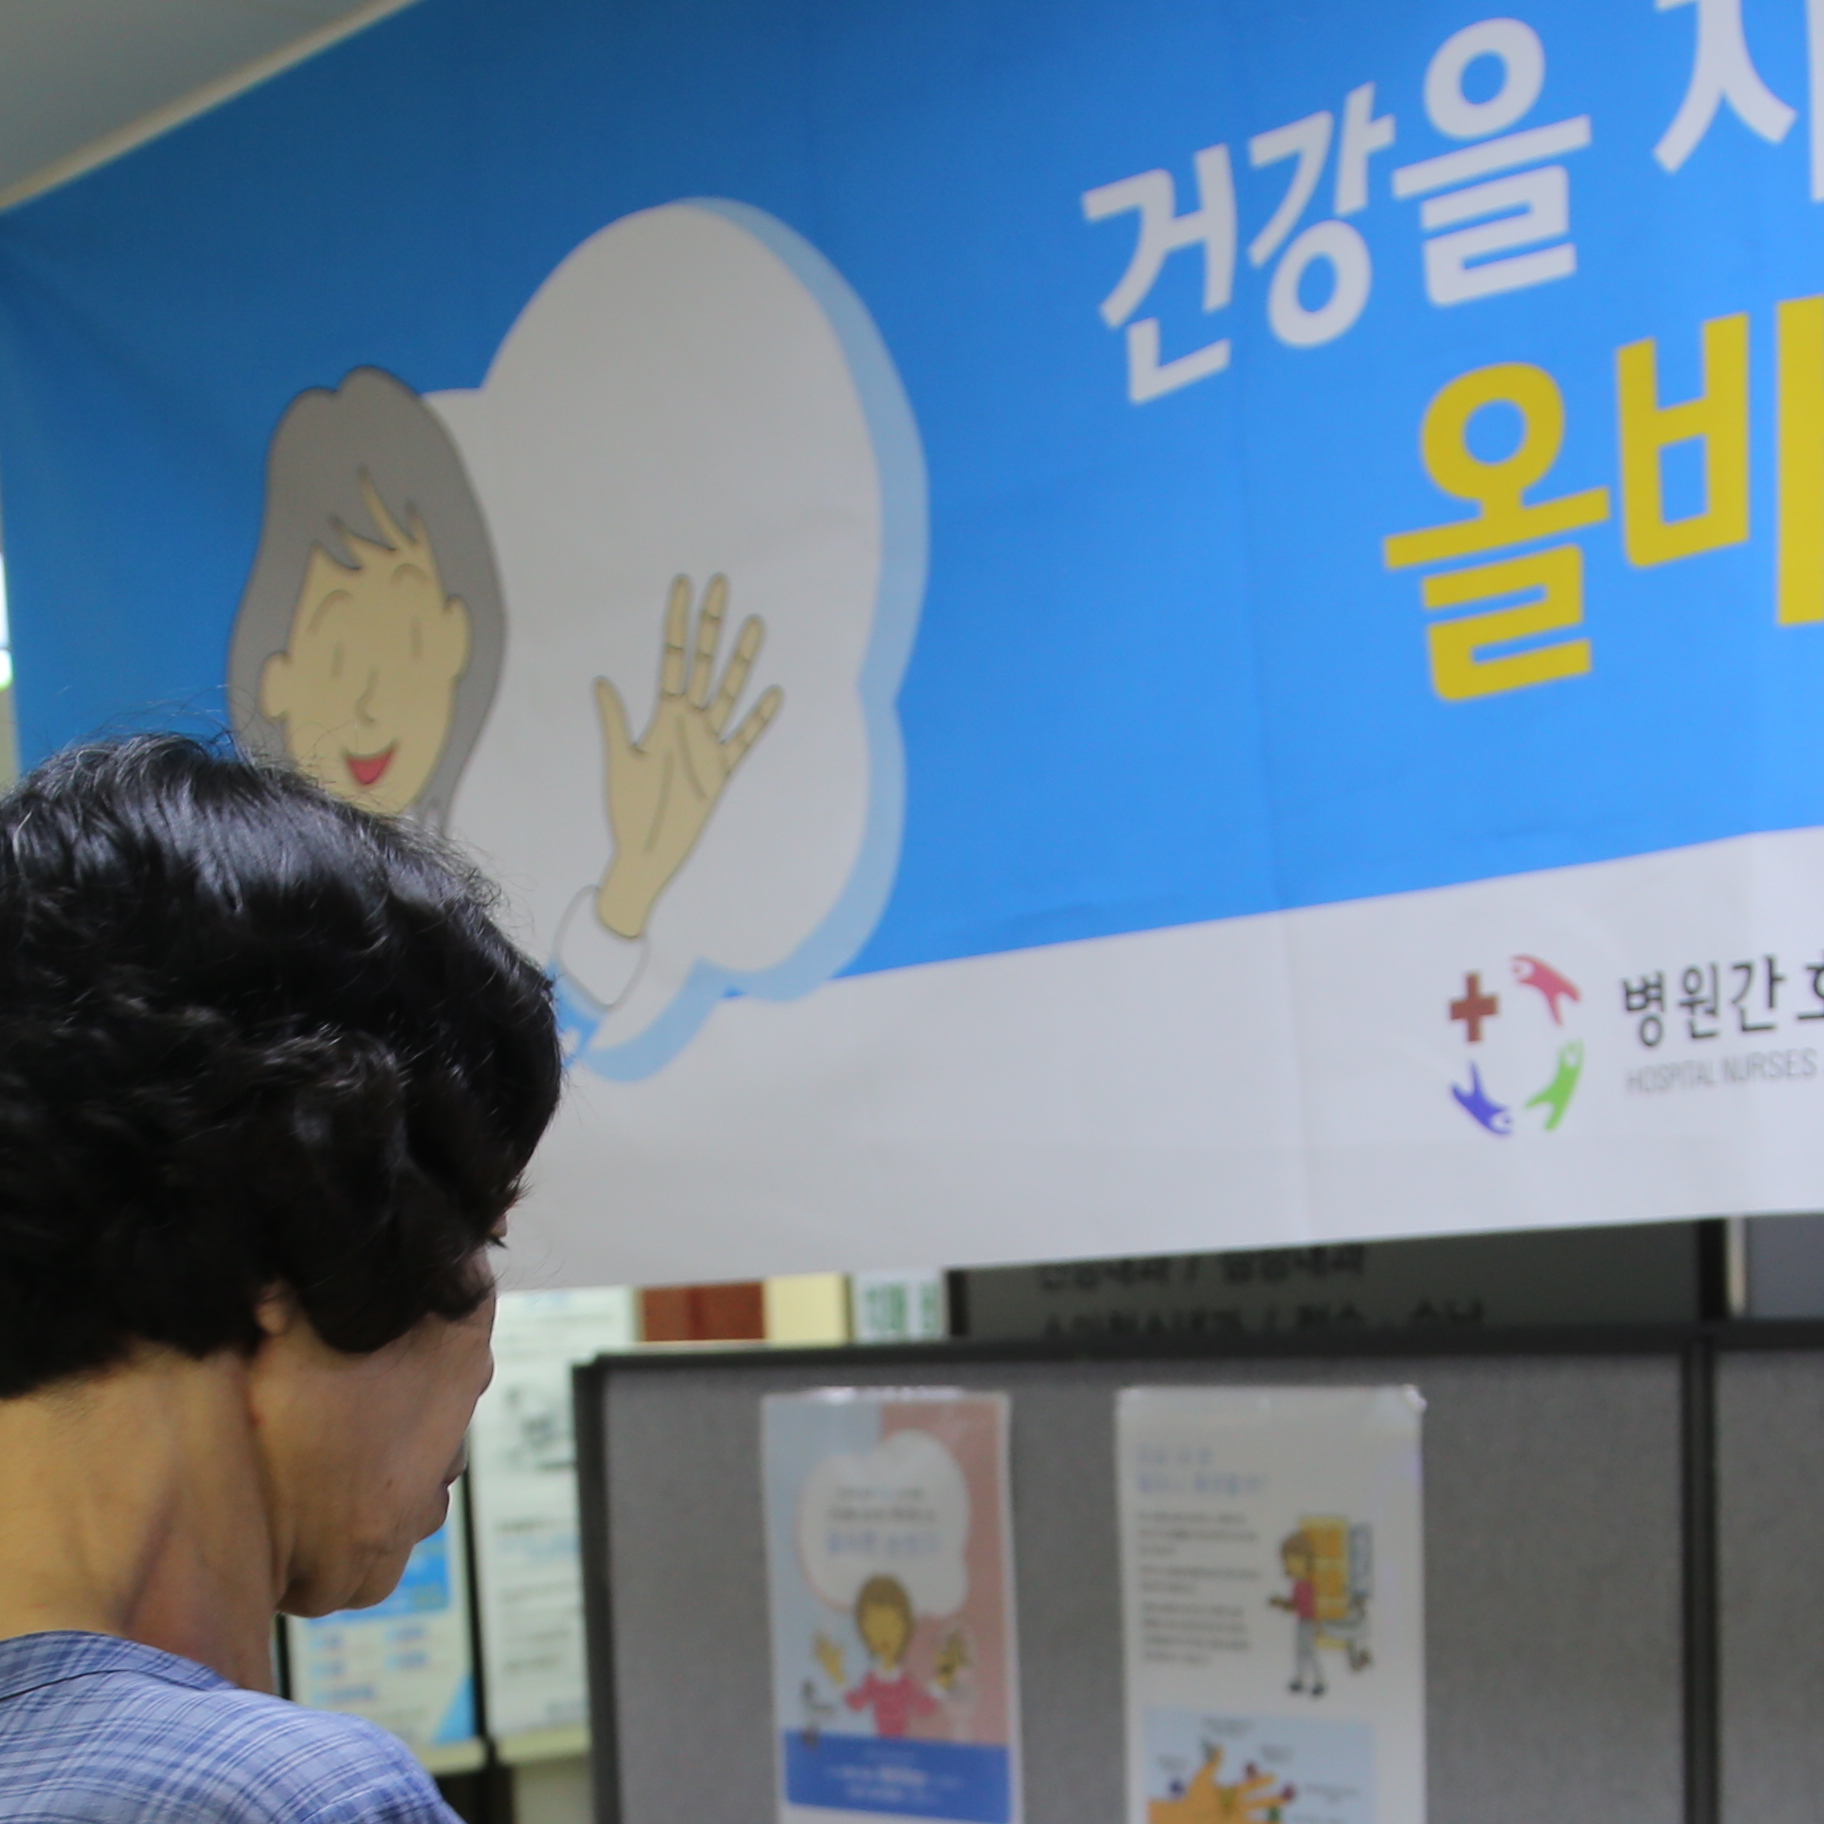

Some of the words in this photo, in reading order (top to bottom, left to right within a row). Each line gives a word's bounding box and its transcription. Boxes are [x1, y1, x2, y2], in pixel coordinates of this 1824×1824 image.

[1081, 17, 1591, 403] 건강을
[1626, 1056, 1716, 1094] HOSPITAL
[1720, 1047, 1818, 1084] NURSES
